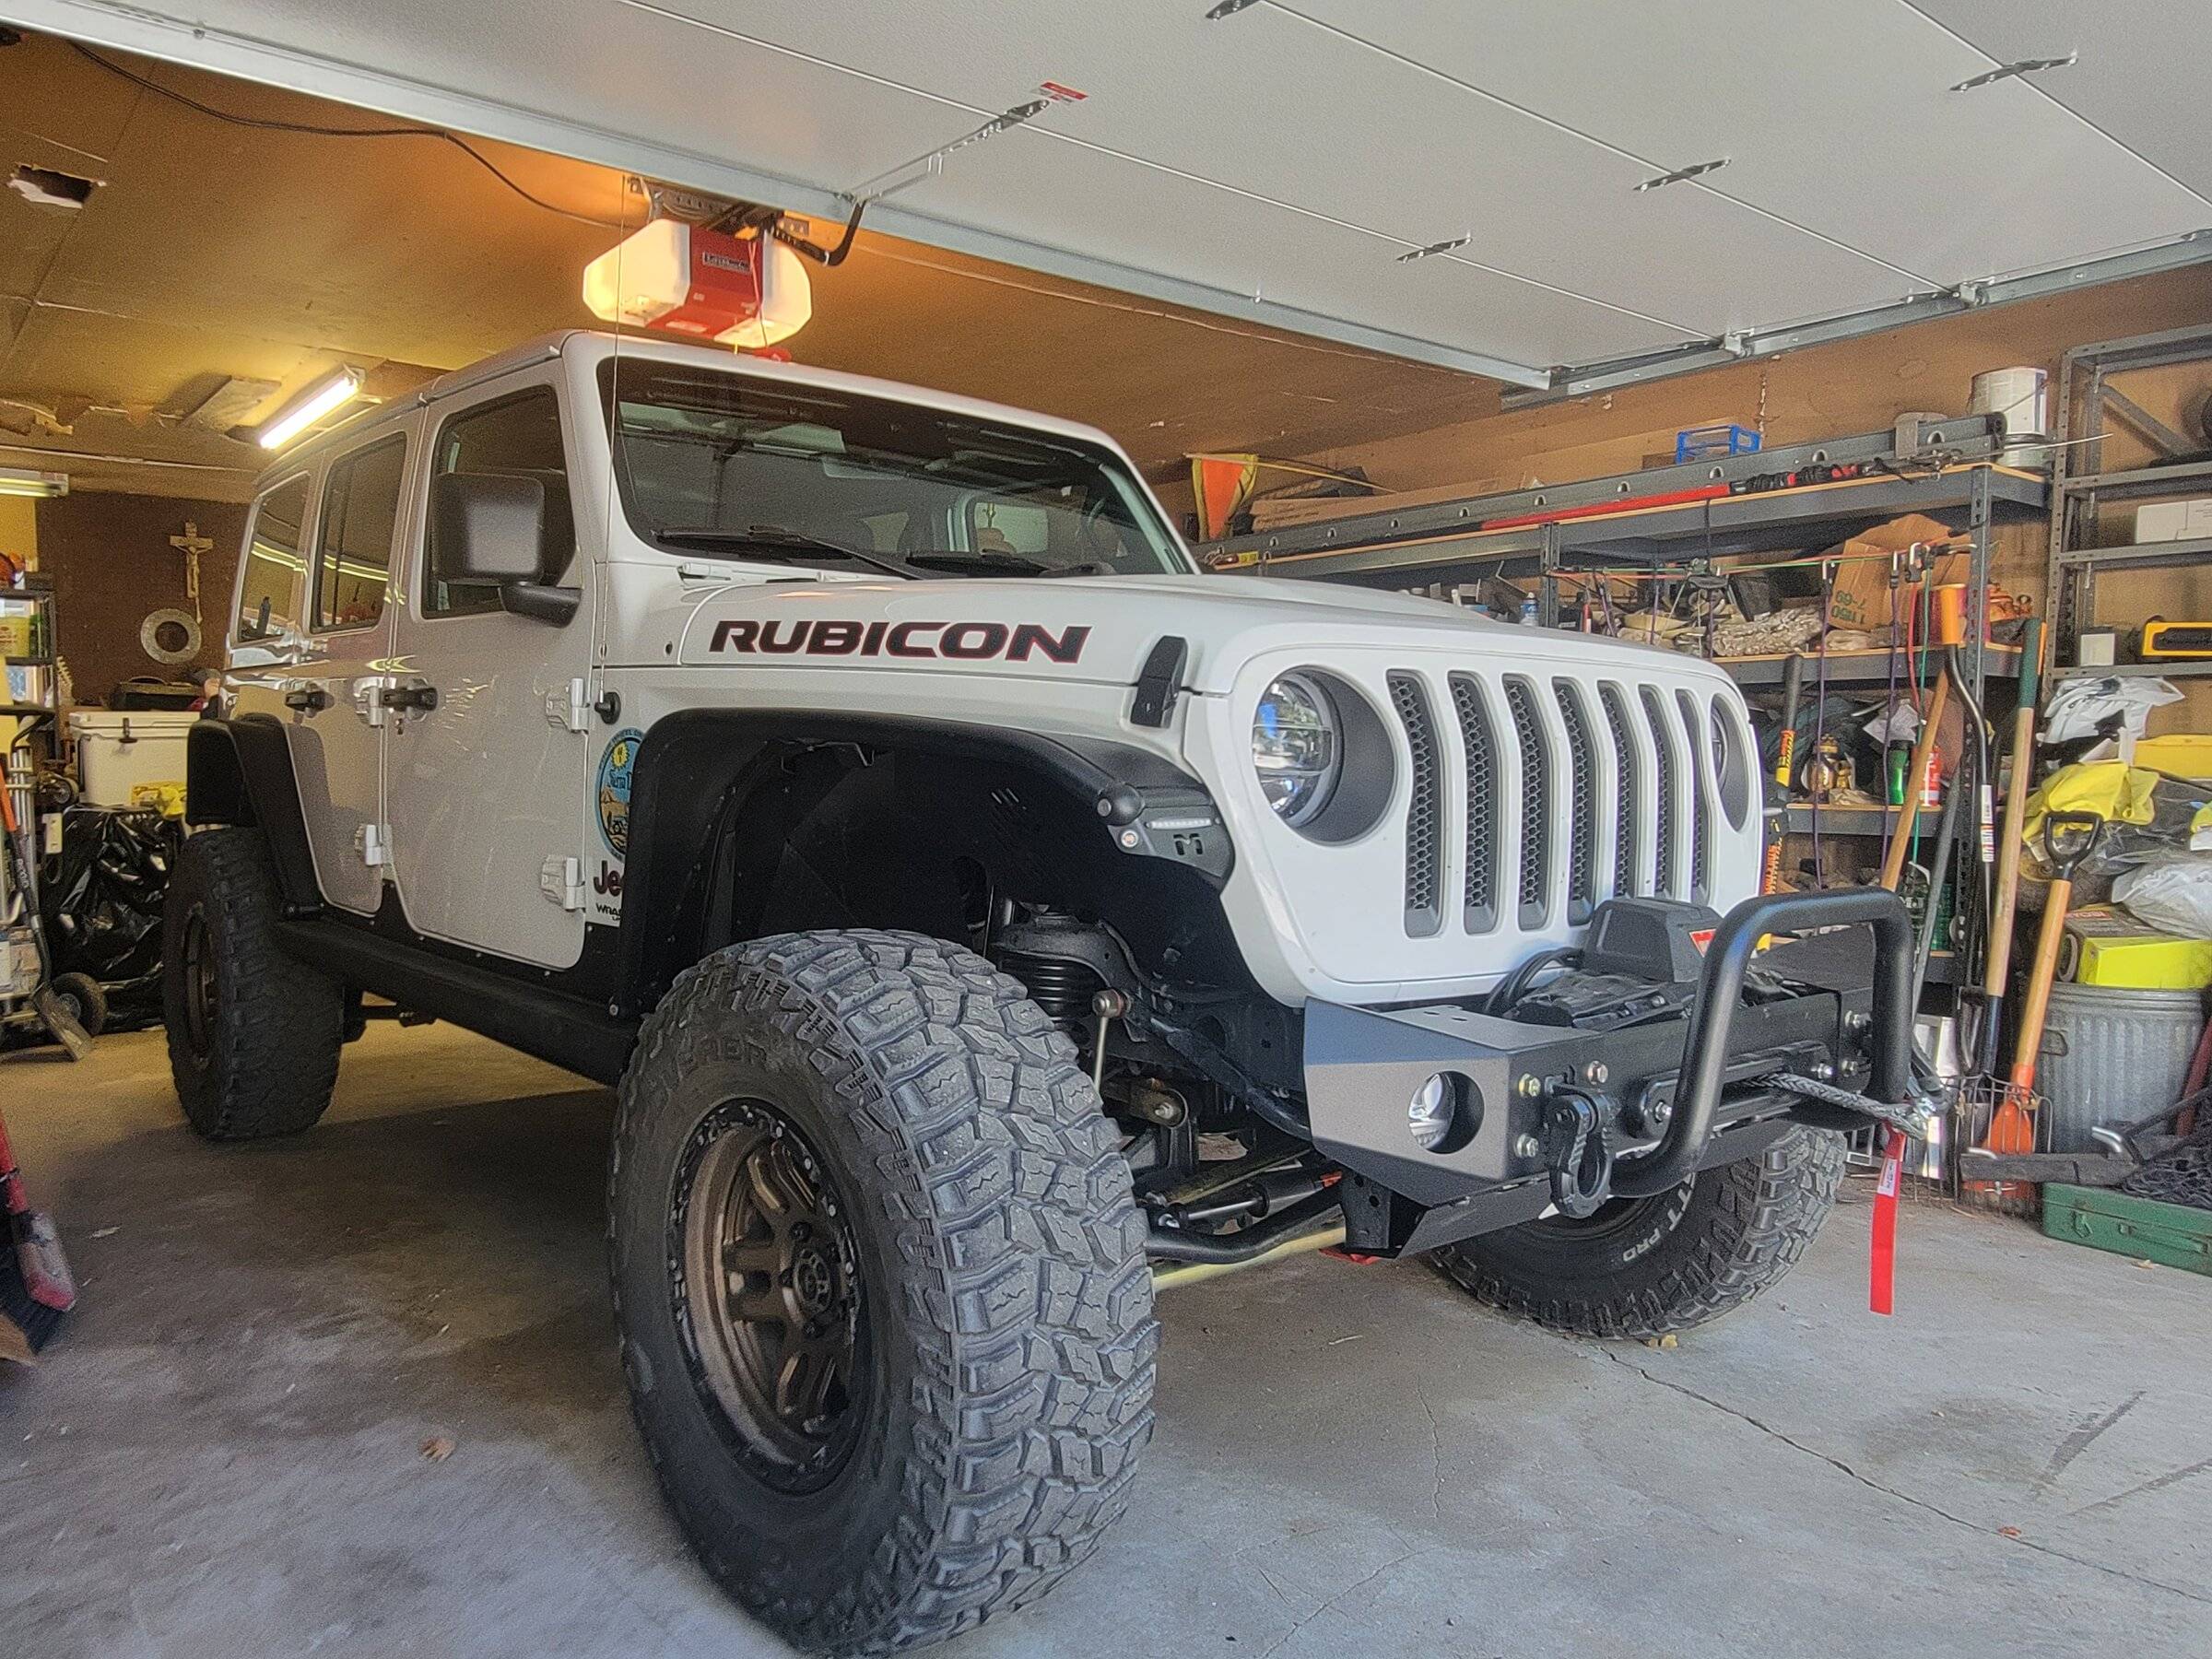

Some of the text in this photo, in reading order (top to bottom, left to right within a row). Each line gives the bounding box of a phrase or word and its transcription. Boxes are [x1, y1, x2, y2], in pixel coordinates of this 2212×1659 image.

[709, 620, 1092, 664] RUBICON
[593, 859, 624, 898] Je
[1622, 1227, 1661, 1262] PRO
